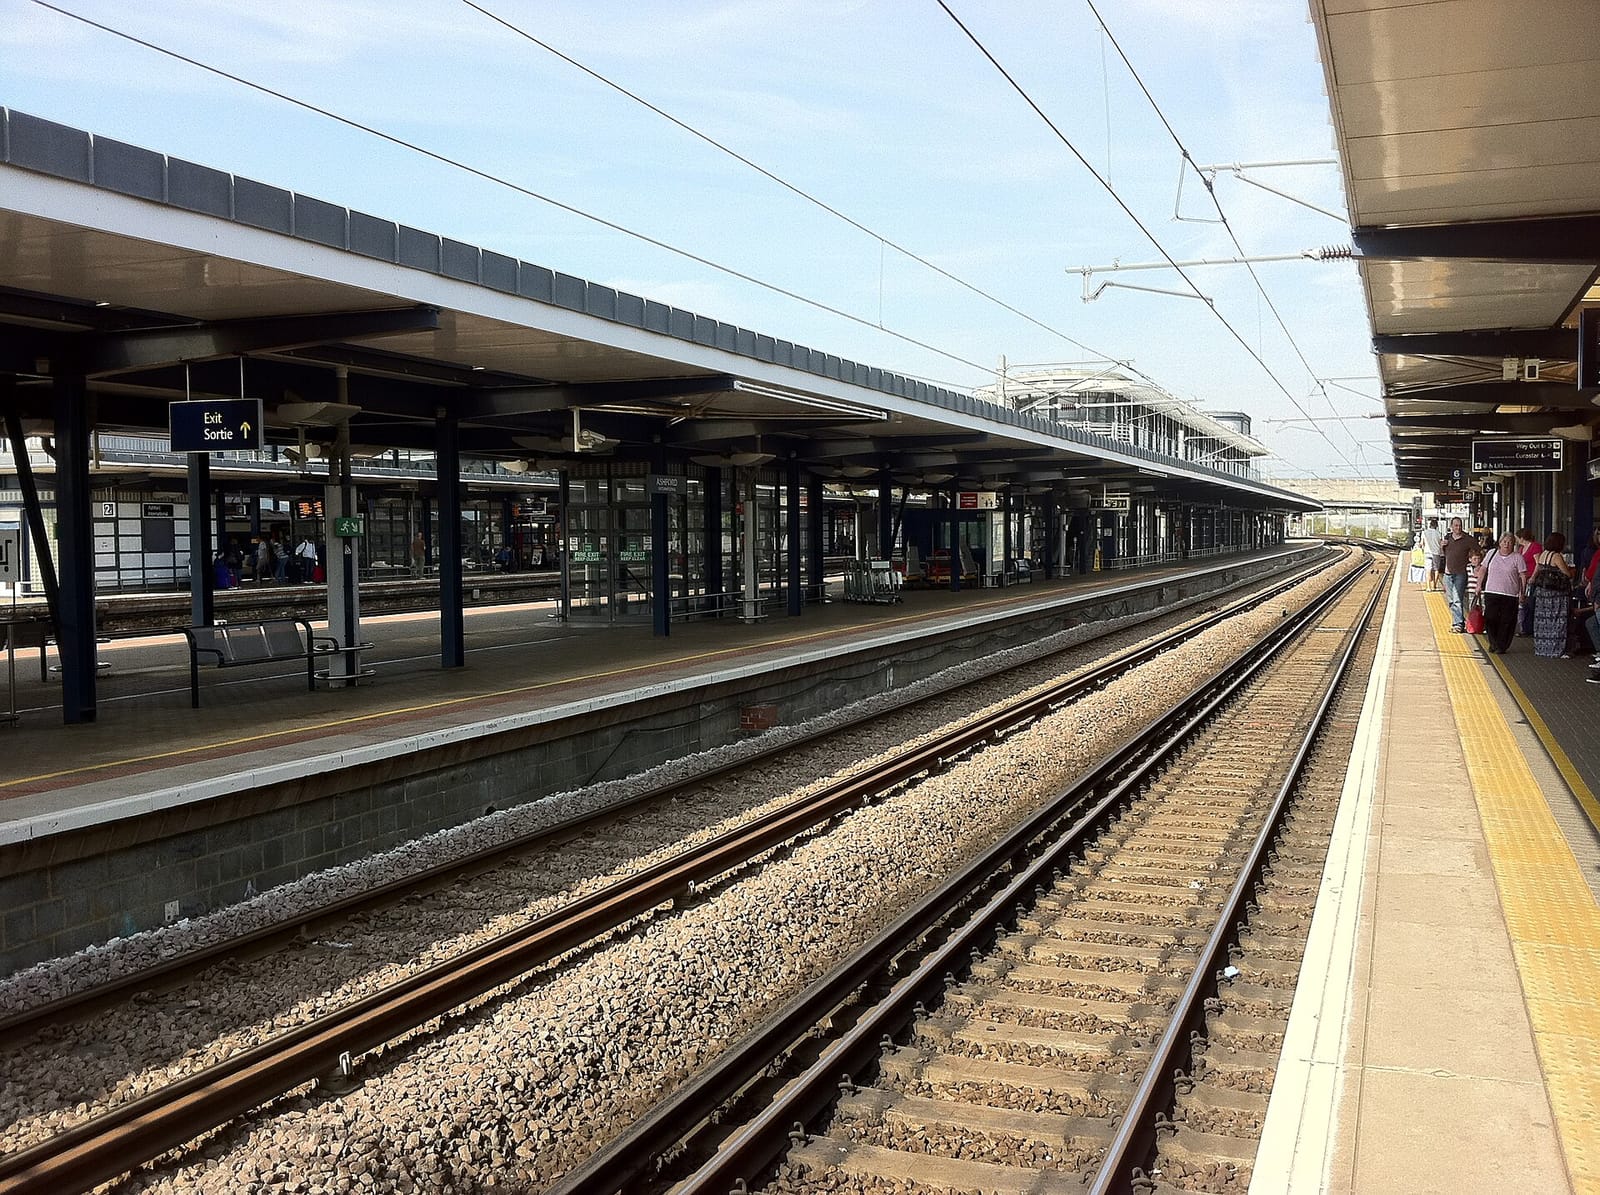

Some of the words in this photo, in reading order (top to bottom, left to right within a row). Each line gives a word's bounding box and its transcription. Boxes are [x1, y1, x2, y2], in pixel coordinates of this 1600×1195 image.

[204, 411, 222, 424] Exit
[204, 427, 233, 440] Sortie
[1453, 469, 1460, 478] 6
[1453, 480, 1460, 488] 4
